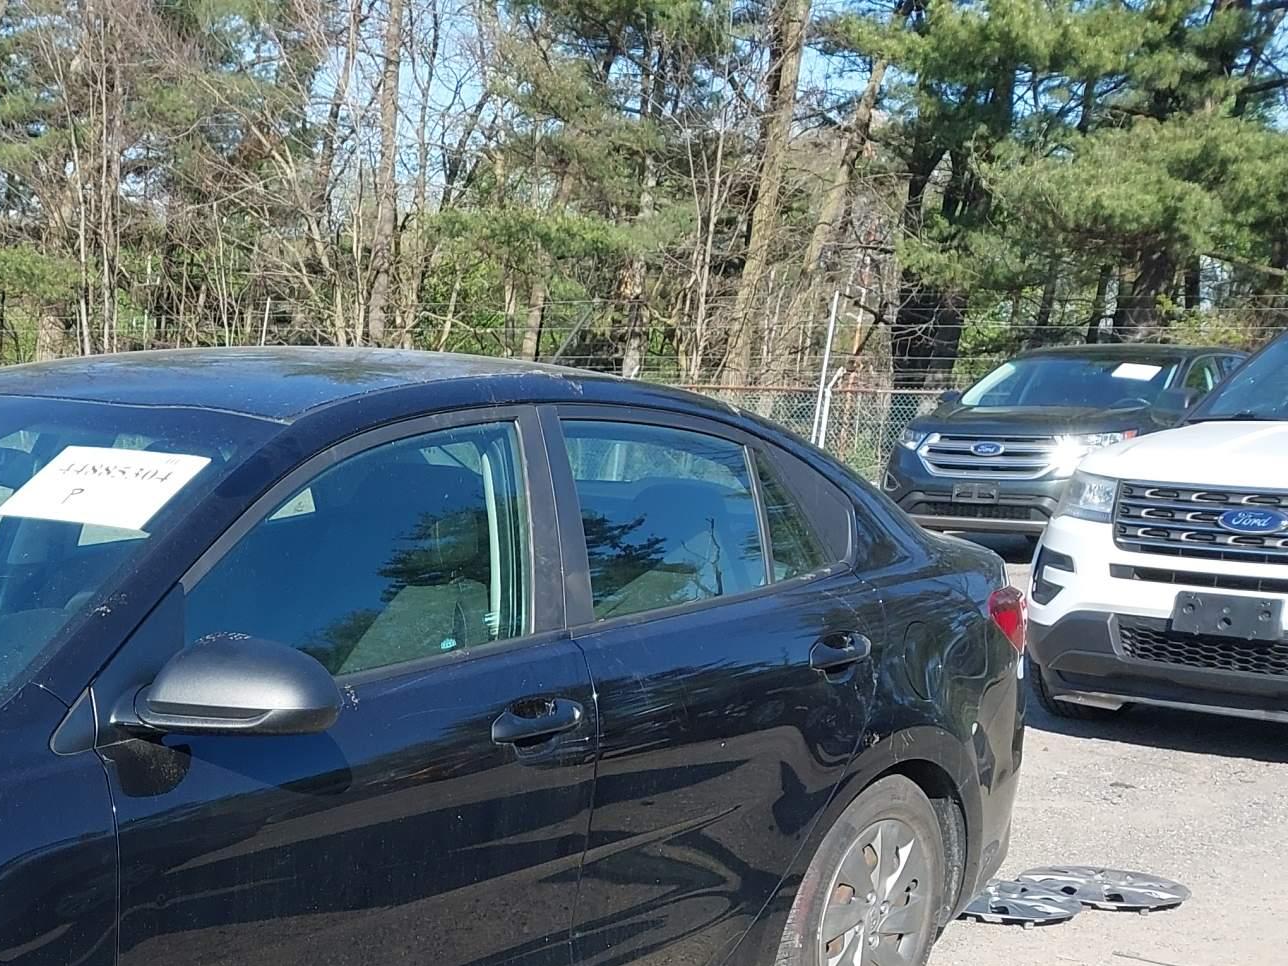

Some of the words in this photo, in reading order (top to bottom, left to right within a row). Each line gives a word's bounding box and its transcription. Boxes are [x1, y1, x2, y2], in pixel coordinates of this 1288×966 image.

[58, 463, 174, 484] 44885304
[60, 487, 85, 505] P
[1232, 511, 1273, 527] Ford
